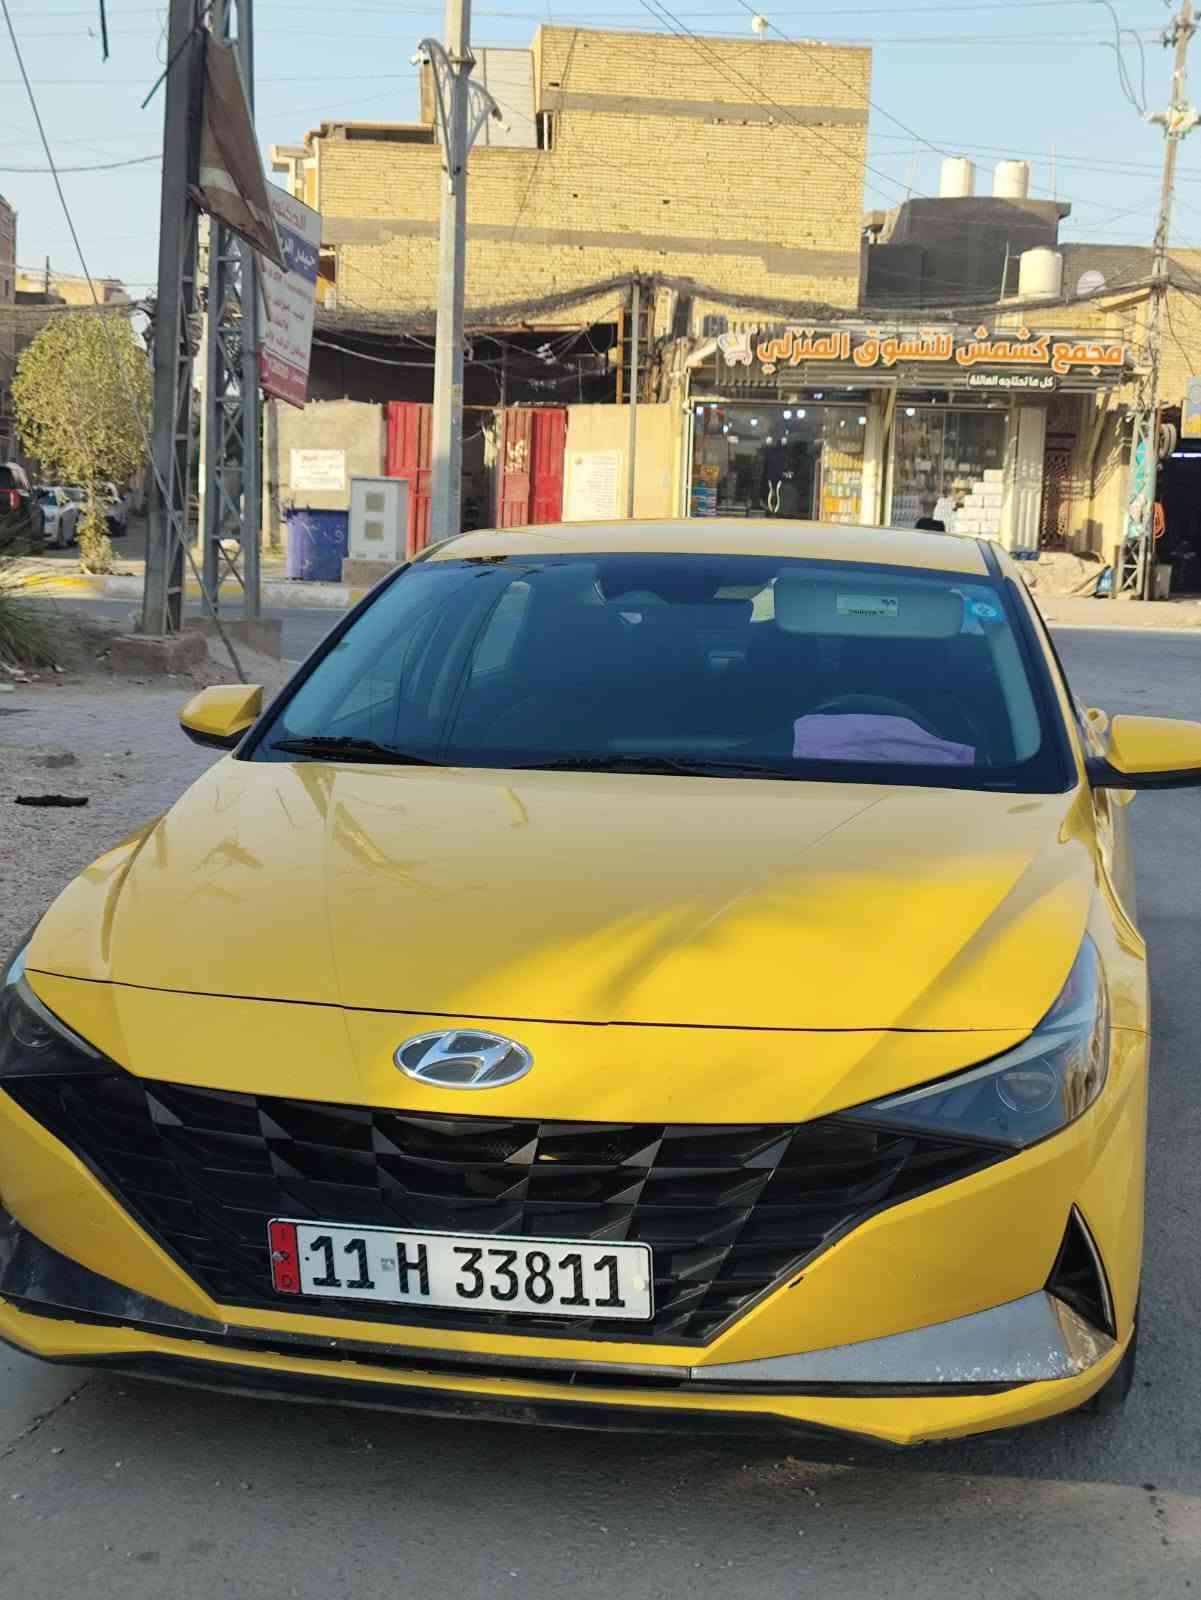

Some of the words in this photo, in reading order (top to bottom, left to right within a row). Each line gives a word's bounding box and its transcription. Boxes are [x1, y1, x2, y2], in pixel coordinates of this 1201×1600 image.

[757, 329, 850, 374] المنزلي
[853, 327, 952, 368] للتسوق
[957, 326, 1050, 367] كشمش
[1050, 343, 1125, 376] مجمع
[1039, 376, 1054, 389] كل
[310, 1235, 375, 1290] 11
[396, 1242, 430, 1296] H
[453, 1246, 626, 1308] 33811
